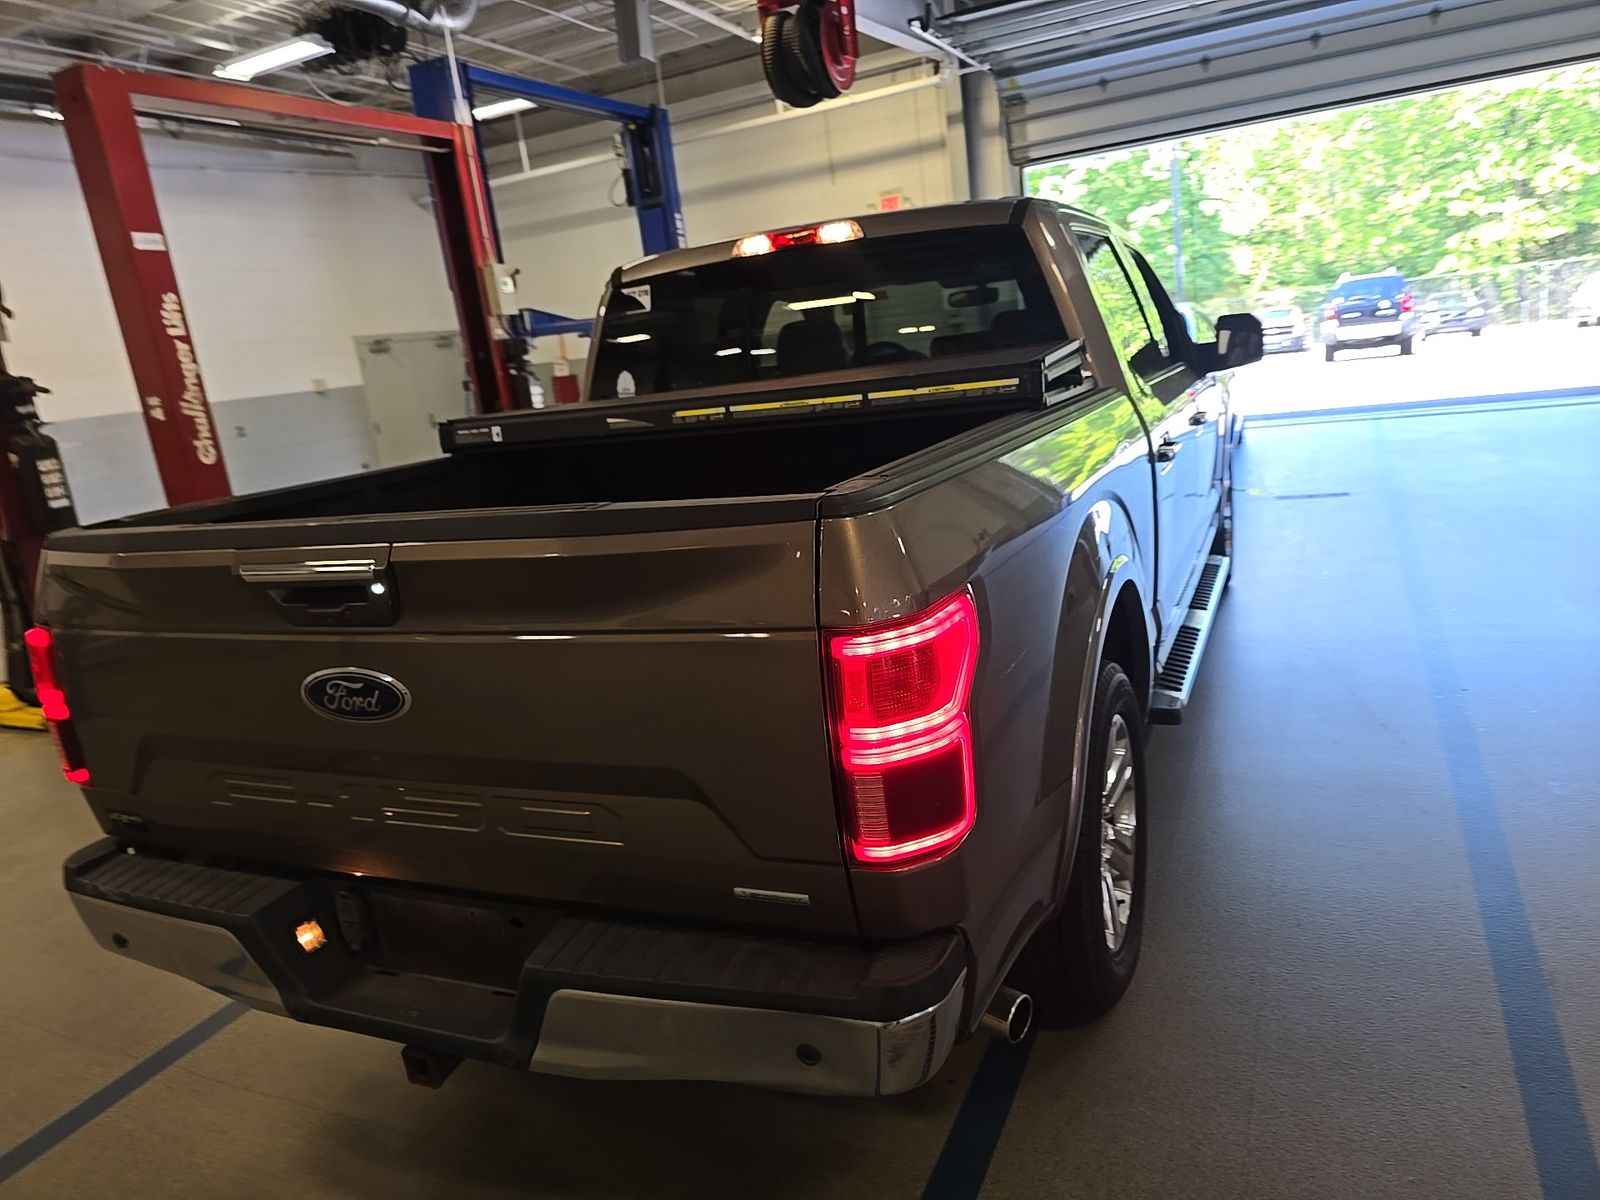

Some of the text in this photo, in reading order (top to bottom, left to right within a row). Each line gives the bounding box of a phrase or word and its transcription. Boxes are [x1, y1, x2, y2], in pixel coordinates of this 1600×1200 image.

[159, 291, 218, 466] Challenger Lifts
[323, 679, 381, 713] Ford
